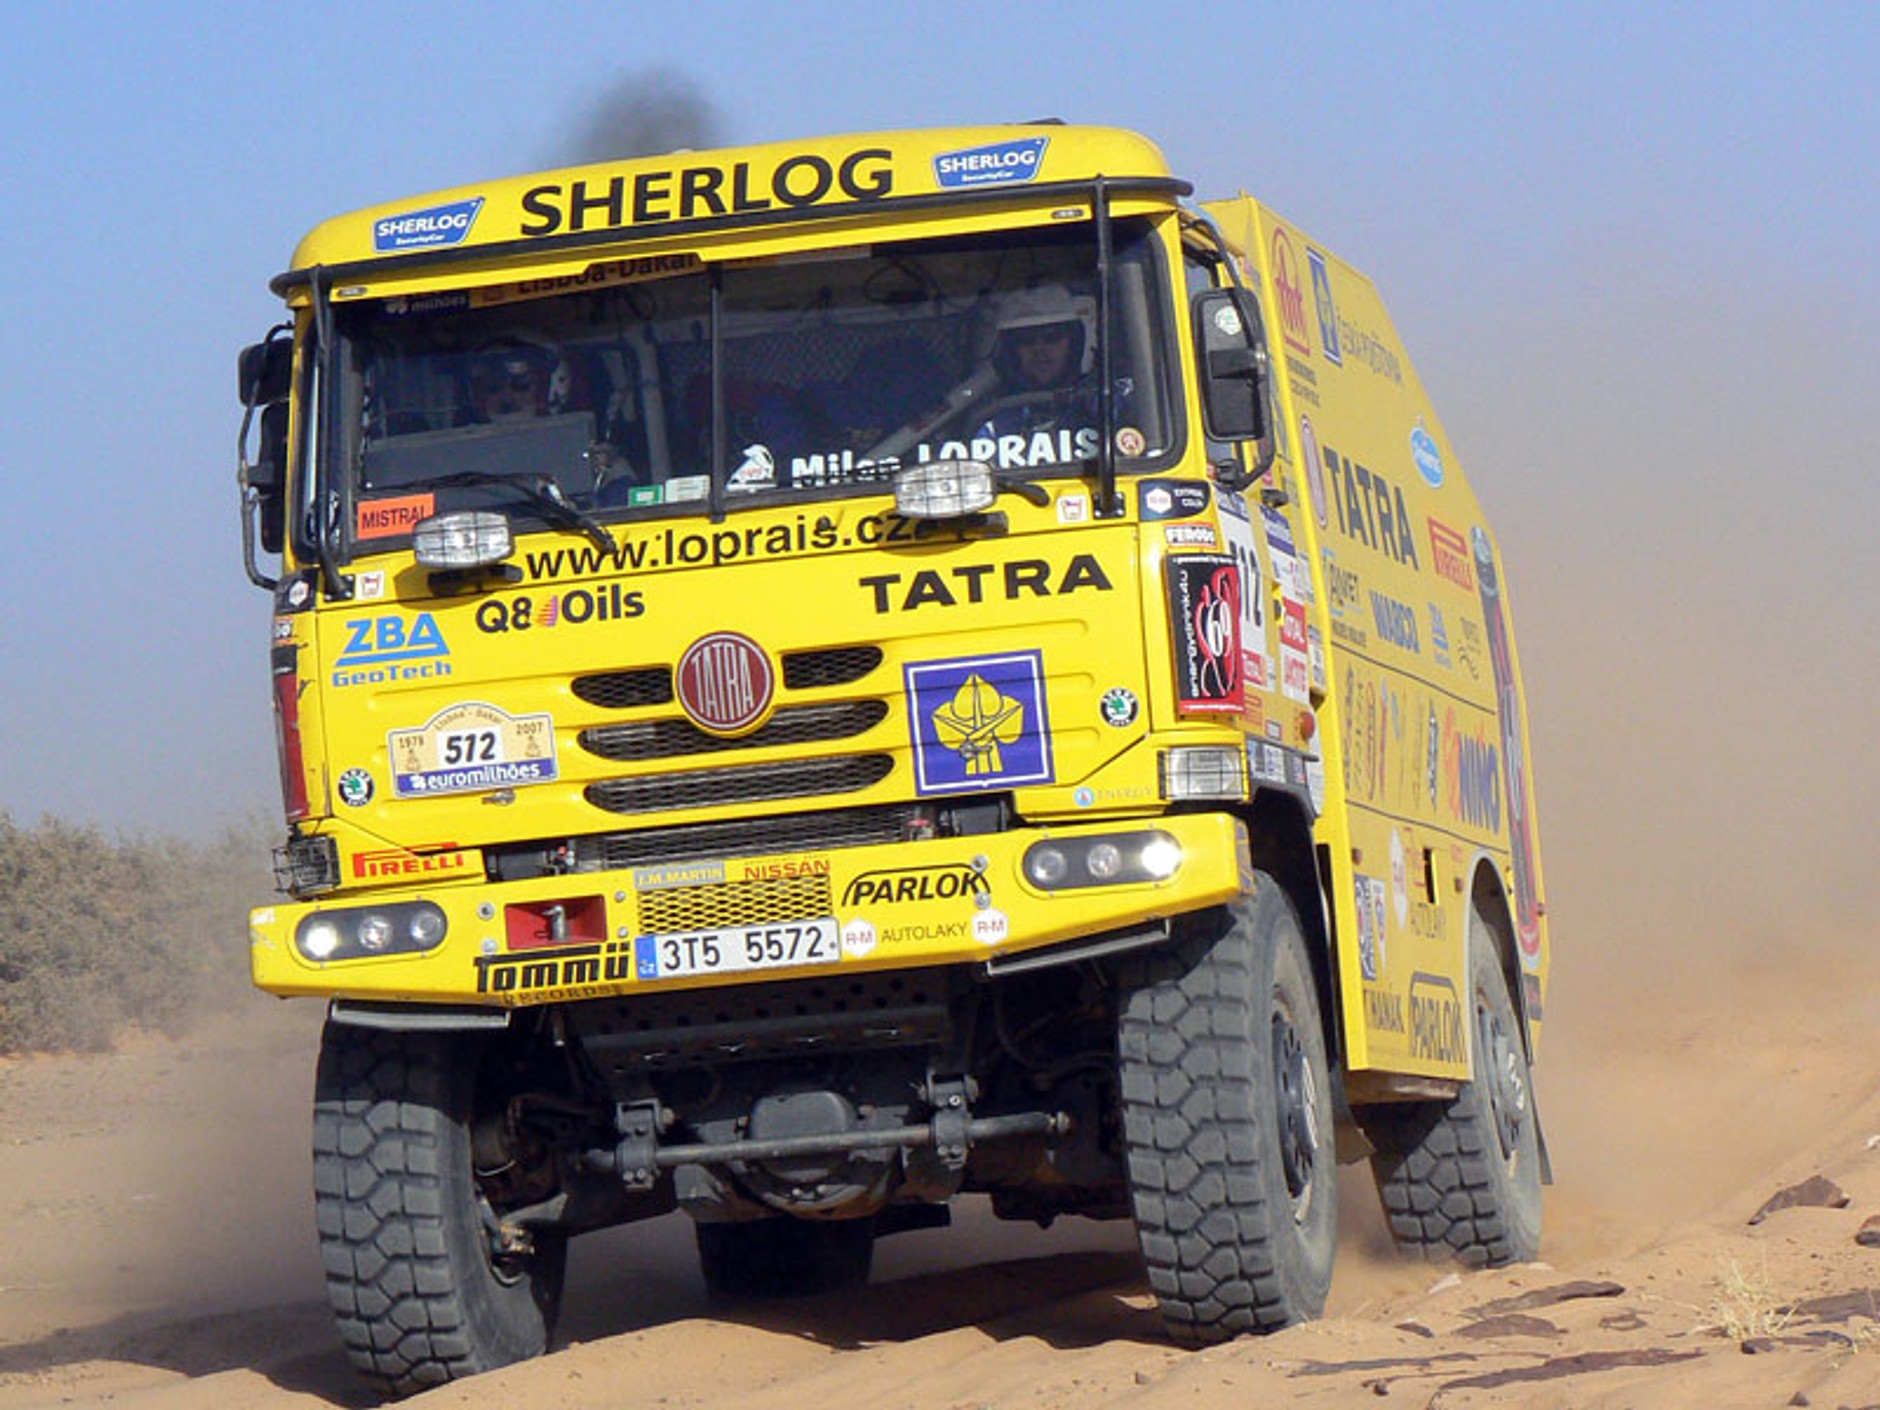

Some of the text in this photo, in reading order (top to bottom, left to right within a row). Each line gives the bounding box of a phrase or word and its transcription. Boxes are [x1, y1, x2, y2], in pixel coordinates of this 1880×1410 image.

[935, 150, 1036, 173] SHERLOG
[520, 150, 894, 236] SHERLOG
[377, 213, 468, 236] SHERLOG
[362, 505, 428, 530] MISTRAL
[1322, 445, 1420, 572] TATRA
[526, 513, 915, 581] www.loprais.cz
[858, 553, 1113, 615] TATRA
[476, 584, 645, 633] Q8 Oils
[342, 613, 450, 655] ZBA
[332, 660, 452, 688] GeoTech
[691, 642, 755, 720] TATRA
[444, 731, 497, 766] 512
[428, 765, 541, 789] euromilhões
[353, 841, 465, 878] PIRELLI
[744, 859, 829, 882] NISSAN
[850, 873, 981, 907] PARLOK
[661, 926, 825, 971] 3T5 5572
[881, 920, 968, 945] AUTOLAKY
